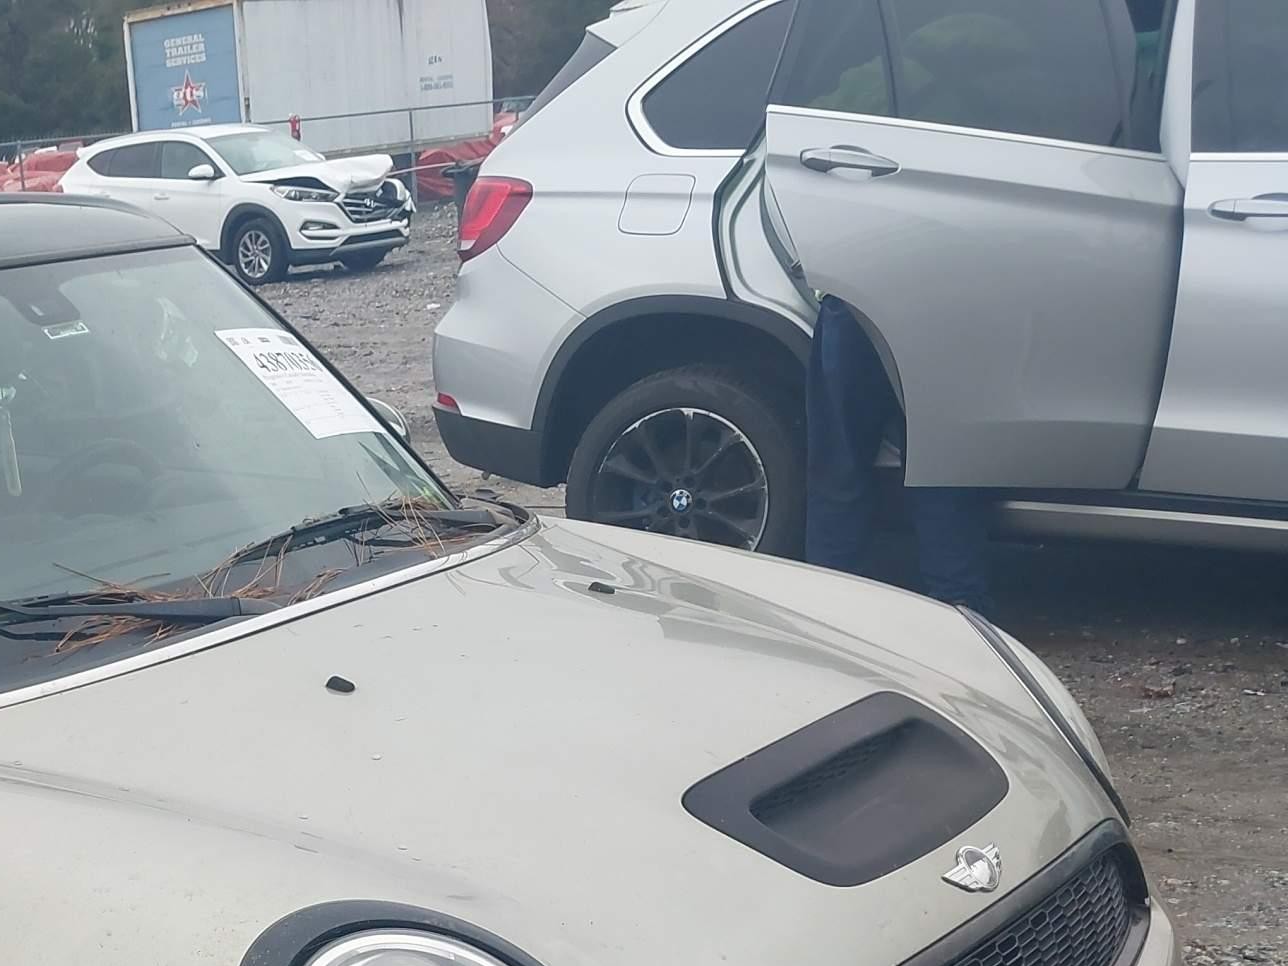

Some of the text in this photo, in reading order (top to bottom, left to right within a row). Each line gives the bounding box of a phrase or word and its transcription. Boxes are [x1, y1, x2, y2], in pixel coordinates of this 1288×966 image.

[164, 33, 205, 47] GENERAL
[165, 42, 206, 58] TRAILER
[165, 52, 207, 68] SERVICES
